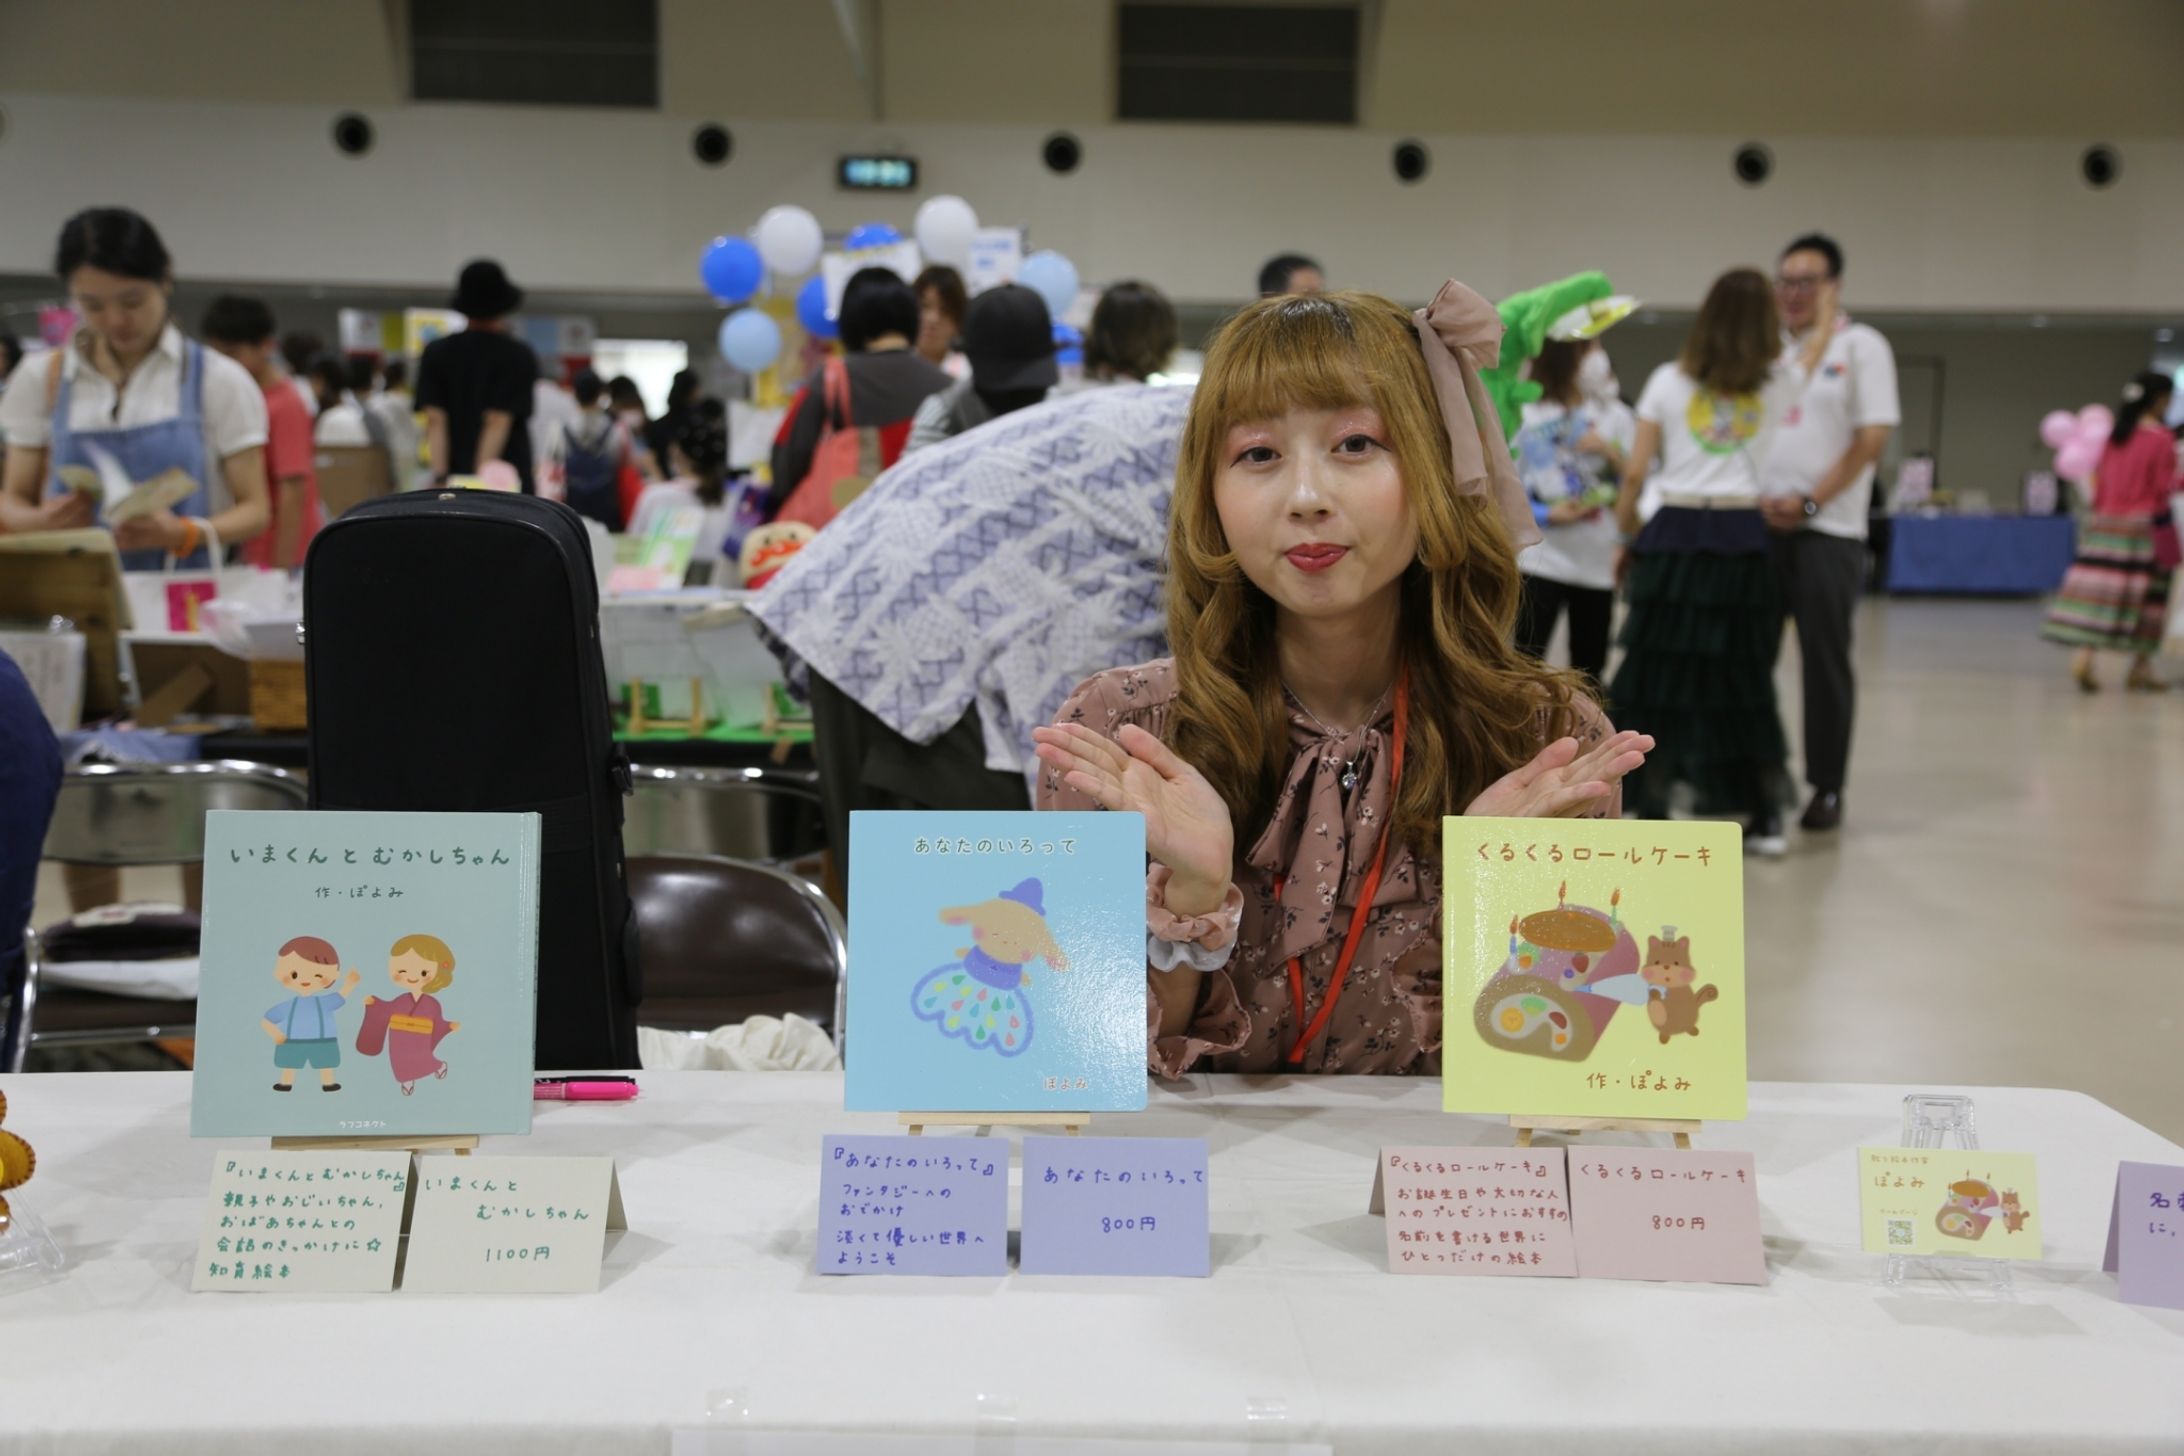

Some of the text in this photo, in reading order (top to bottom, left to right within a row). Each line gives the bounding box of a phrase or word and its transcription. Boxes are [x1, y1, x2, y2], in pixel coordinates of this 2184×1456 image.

[915, 838, 1076, 854] あなたのいろって
[1477, 843, 1711, 866] くるくるロールケーキ
[1586, 1070, 1691, 1091] 作・ぽよみ
[834, 1147, 994, 1176] 『あなたのいろって』
[1391, 1156, 1547, 1177] 『くるくるロールケーキ』
[1044, 1166, 1204, 1184] あなたのいろって
[1581, 1164, 1745, 1183] くるくるロールケーキ
[425, 1176, 518, 1191] いまくんと
[843, 1184, 951, 1198] ファンタジーへの
[1398, 1187, 1559, 1200] お誕生日や大切な人
[476, 1204, 589, 1220] むかしちゃん
[840, 1203, 904, 1217] おでかけ
[220, 1216, 355, 1230] おばあちゃんとの
[1101, 1216, 1156, 1233] 800円
[1652, 1215, 1705, 1230] 800円
[1398, 1230, 1546, 1245] 名前を書ける世界に
[486, 1246, 550, 1262] 1100円
[838, 1251, 896, 1265] ようこそ
[1402, 1250, 1542, 1265] ひとつだけの絵本
[209, 1261, 290, 1280] 知育絵本
